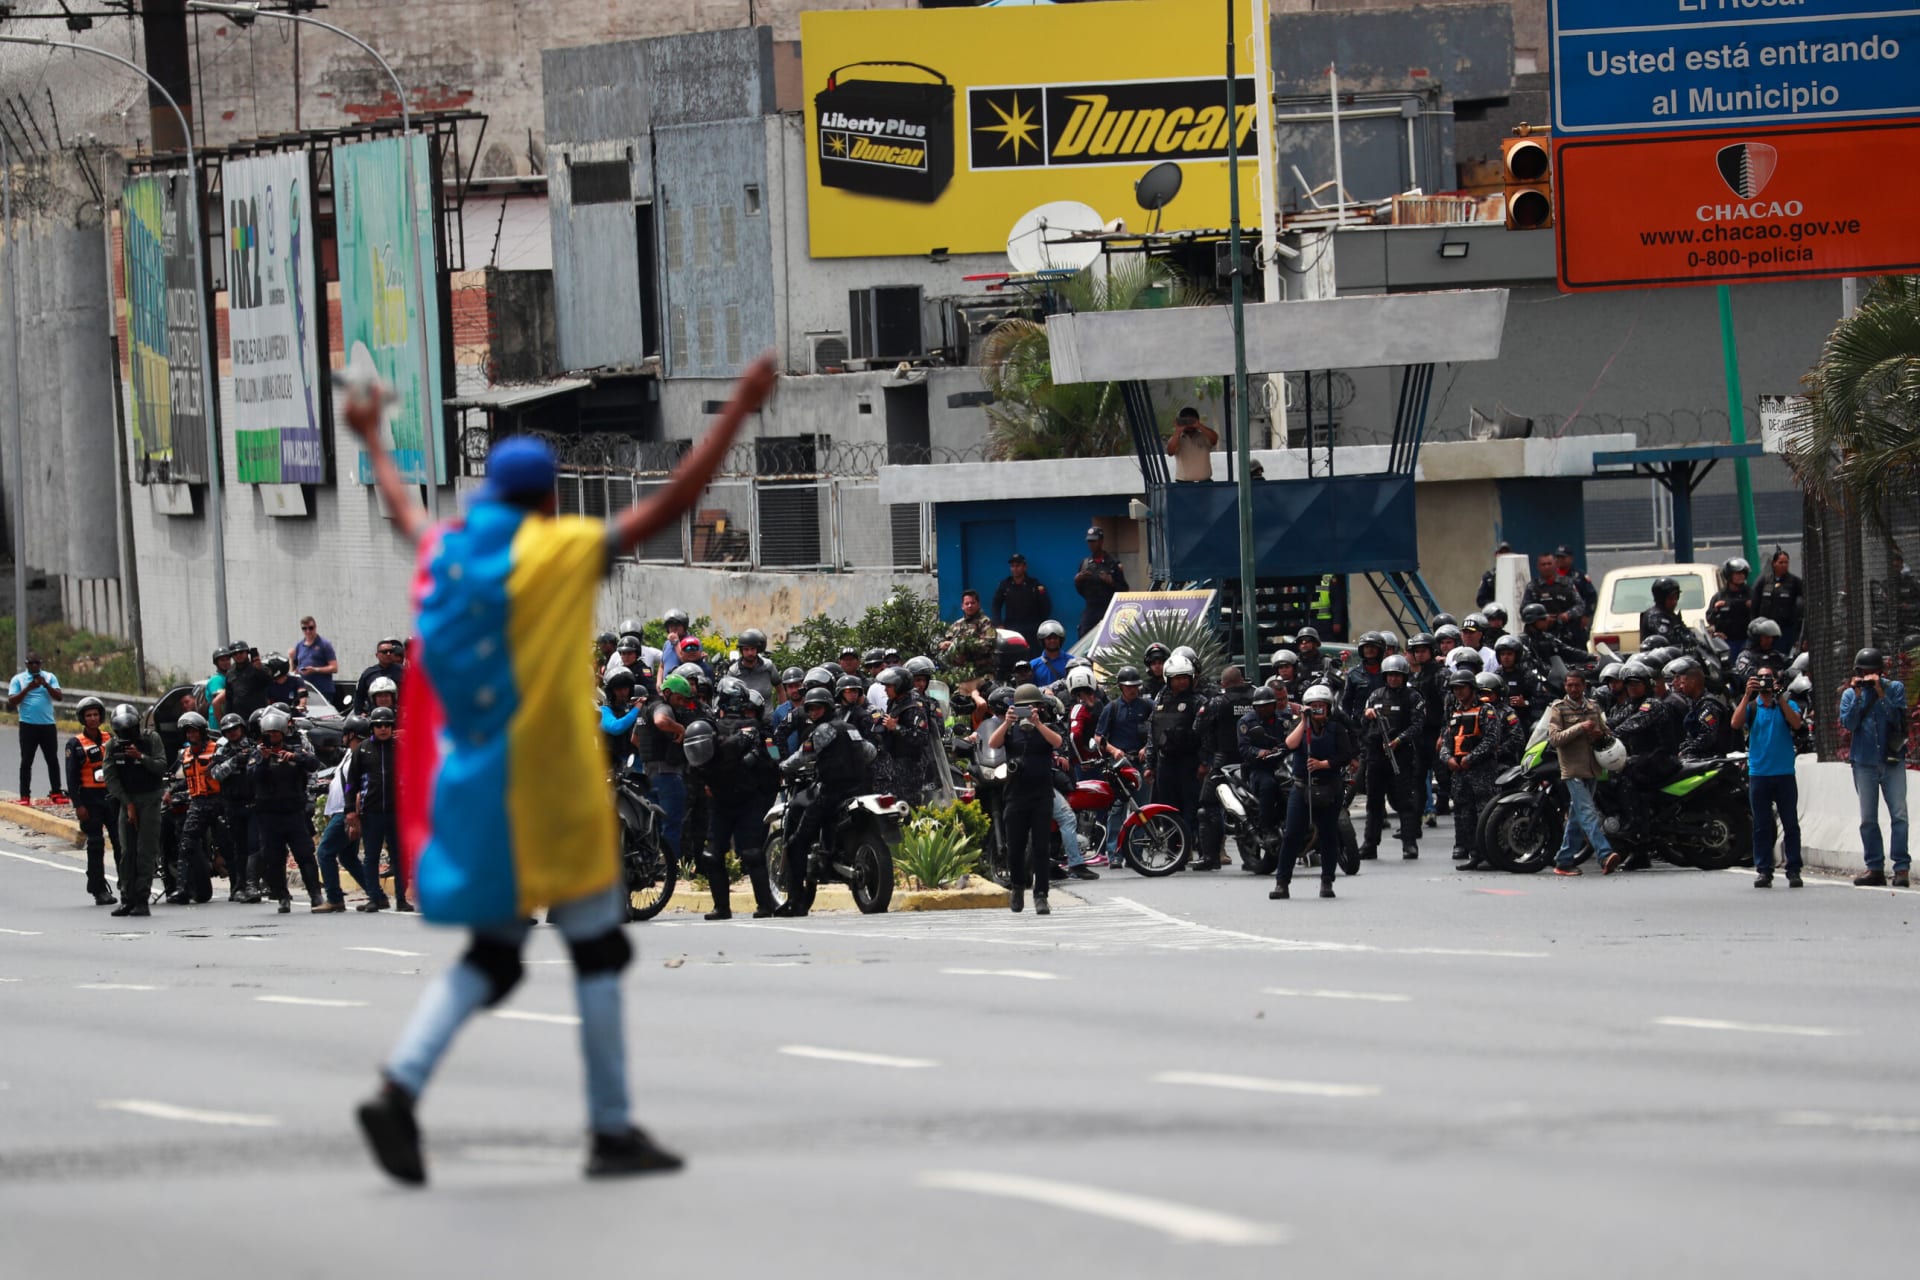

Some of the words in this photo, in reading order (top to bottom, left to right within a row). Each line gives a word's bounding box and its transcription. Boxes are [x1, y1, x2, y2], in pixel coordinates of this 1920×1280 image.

[1587, 46, 1675, 77] Usted
[1685, 41, 1750, 71] está
[1759, 34, 1900, 67] entrando
[1652, 89, 1677, 116] al
[1688, 80, 1839, 114] Municipio
[821, 112, 885, 136] Liberty
[885, 119, 926, 138] Plus
[850, 136, 925, 166] Duncan
[1696, 200, 1803, 222] CHACAO
[1640, 218, 1861, 246] www.chacao.gov.ve
